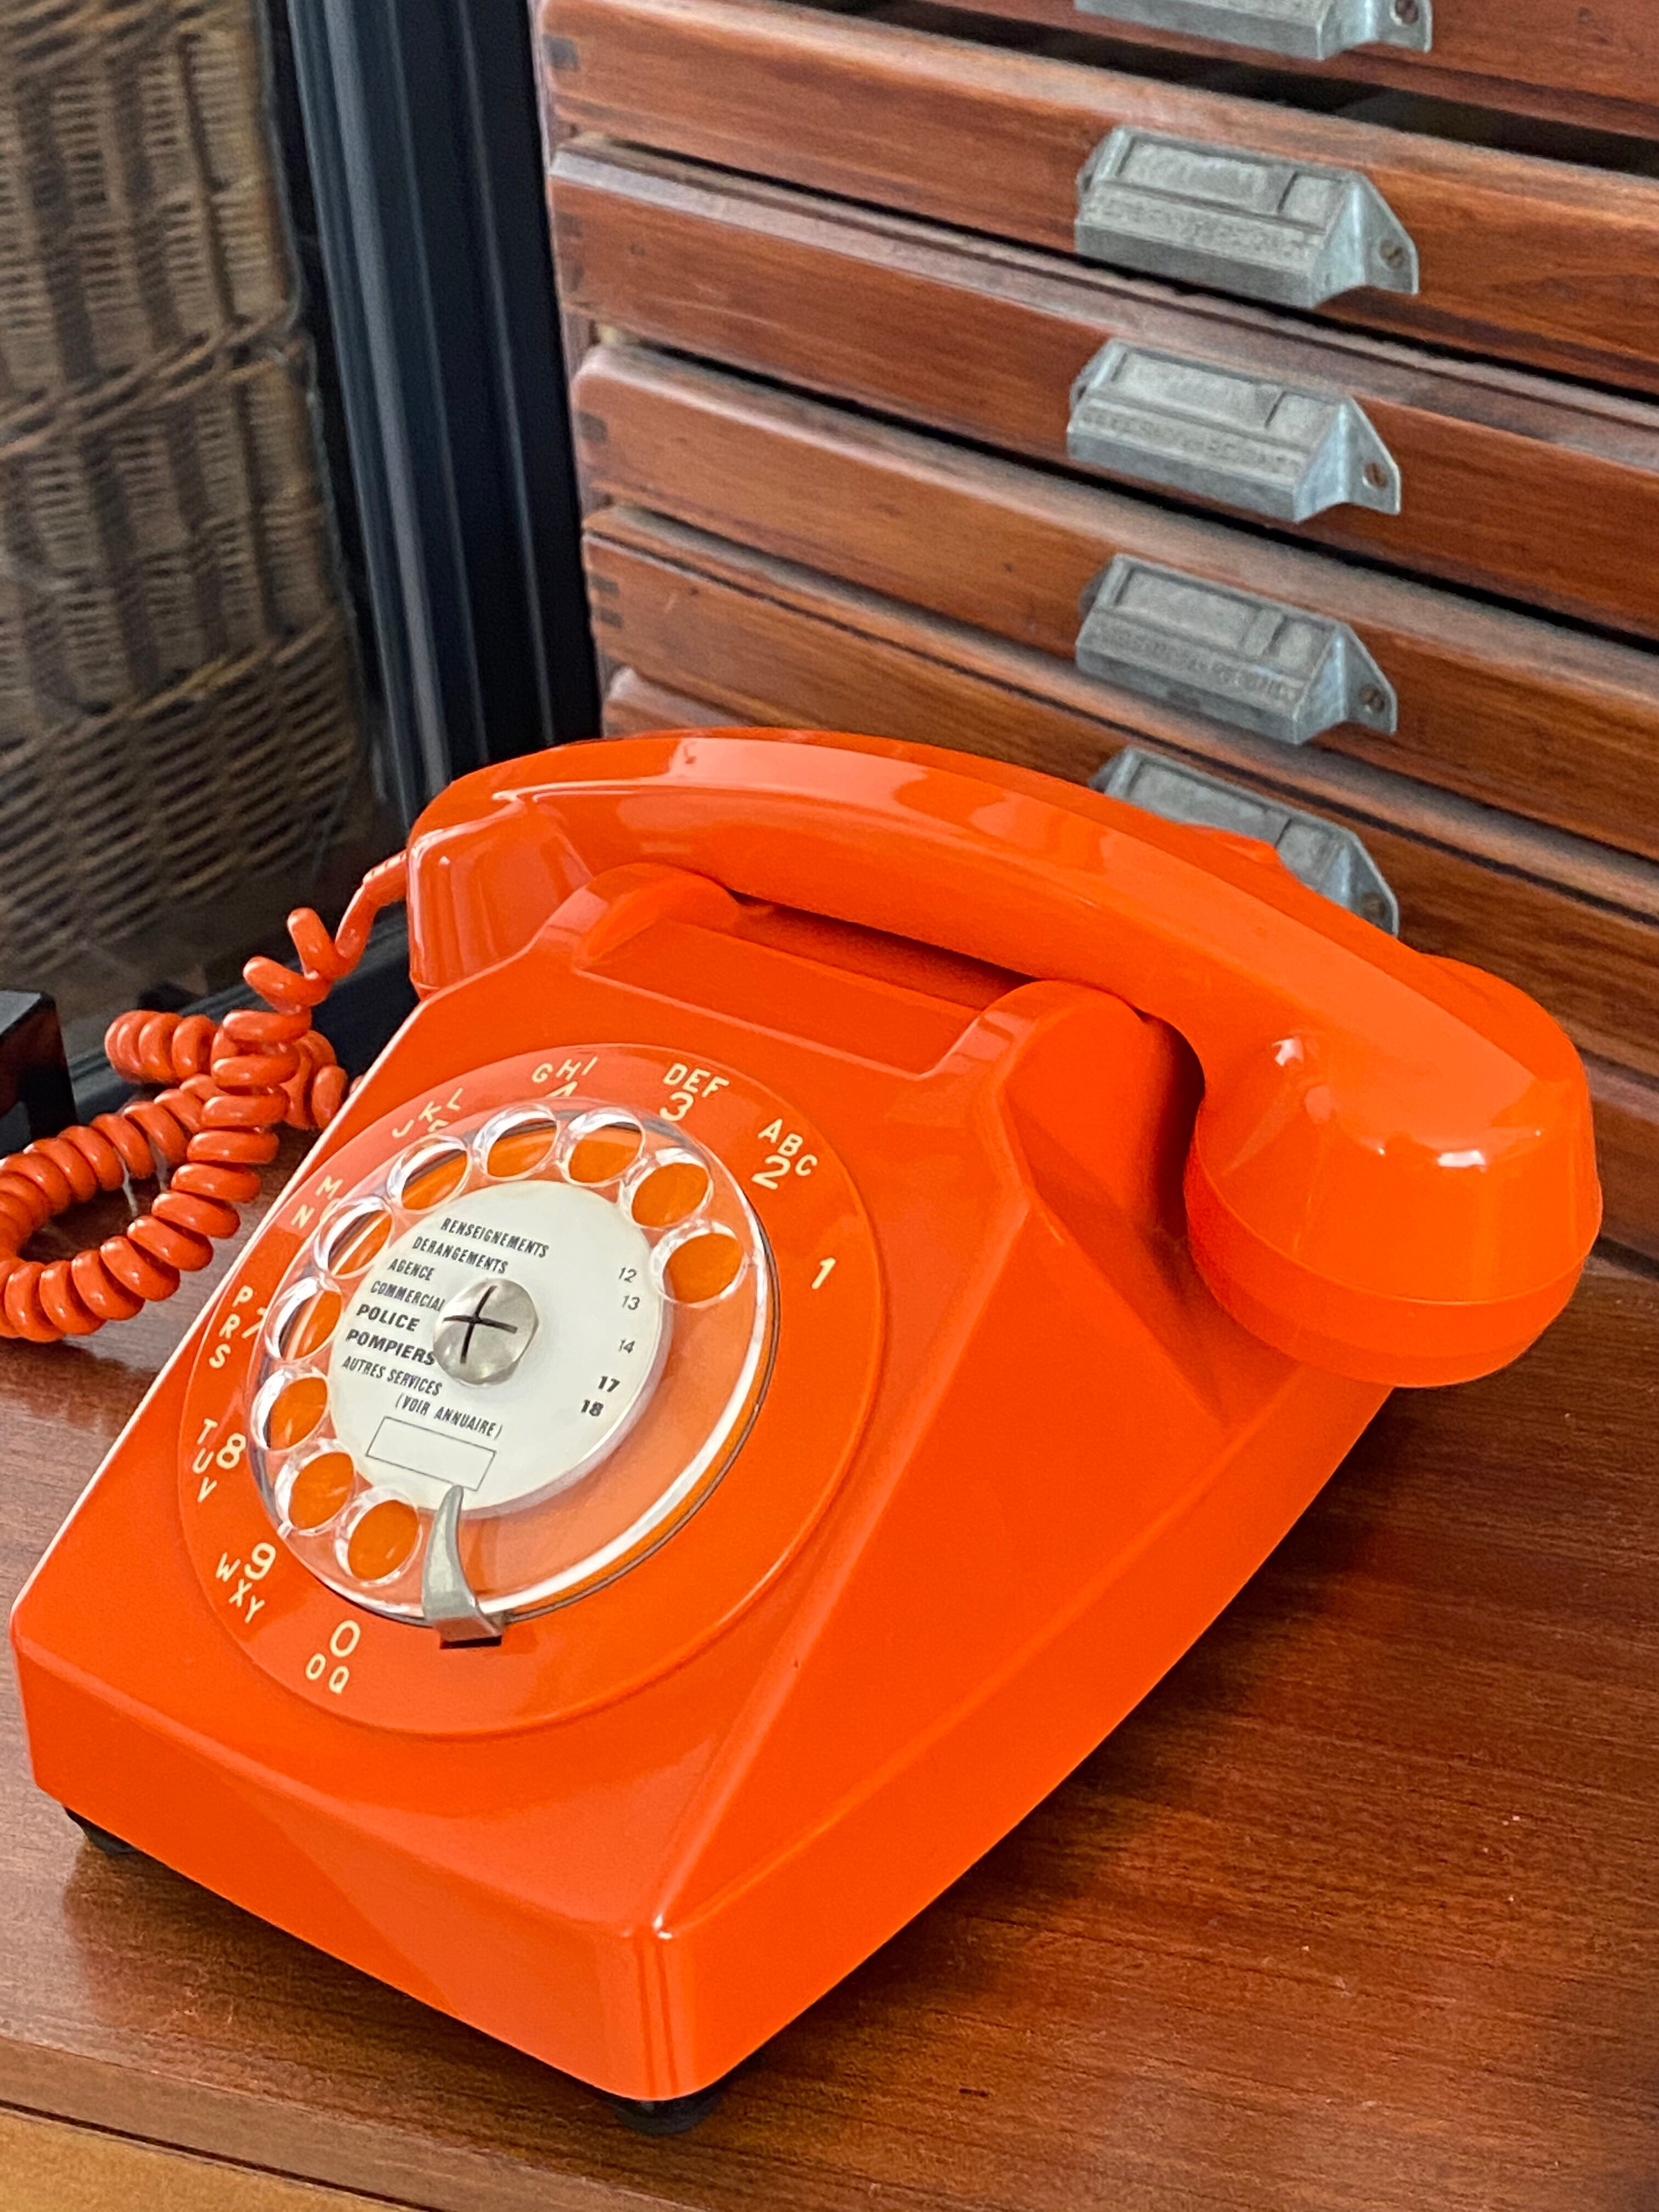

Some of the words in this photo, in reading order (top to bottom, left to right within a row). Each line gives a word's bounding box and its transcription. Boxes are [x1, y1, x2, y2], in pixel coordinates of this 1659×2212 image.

[531, 1056, 597, 1084] GHI
[663, 1063, 729, 1097] DEF
[392, 1087, 463, 1138] JKL
[659, 1092, 694, 1121] 3
[758, 1118, 818, 1176] ABC
[752, 1155, 791, 1189] 2
[388, 1258, 435, 1281] AGENCE
[441, 1217, 549, 1258] RENSEIGNEMENTS
[618, 1266, 637, 1283] 12
[412, 1235, 508, 1274] DERANGEMENTS
[622, 1295, 641, 1311] 13
[811, 1257, 836, 1289] 1
[208, 1285, 253, 1369] PRS
[356, 1304, 420, 1331] POLICE
[597, 1375, 620, 1393] 17
[618, 1339, 635, 1354] 14
[341, 1356, 386, 1378] AUTRES
[387, 1369, 443, 1396] SERVICES
[346, 1329, 435, 1365] POMPIERS
[580, 1399, 604, 1417] 18
[394, 1392, 431, 1416] (VOIR
[434, 1406, 503, 1440] ANNUAIRE)
[192, 1418, 218, 1503] TUV
[216, 1432, 247, 1470] 8
[244, 1542, 276, 1581] 9
[215, 1552, 266, 1624] WXY
